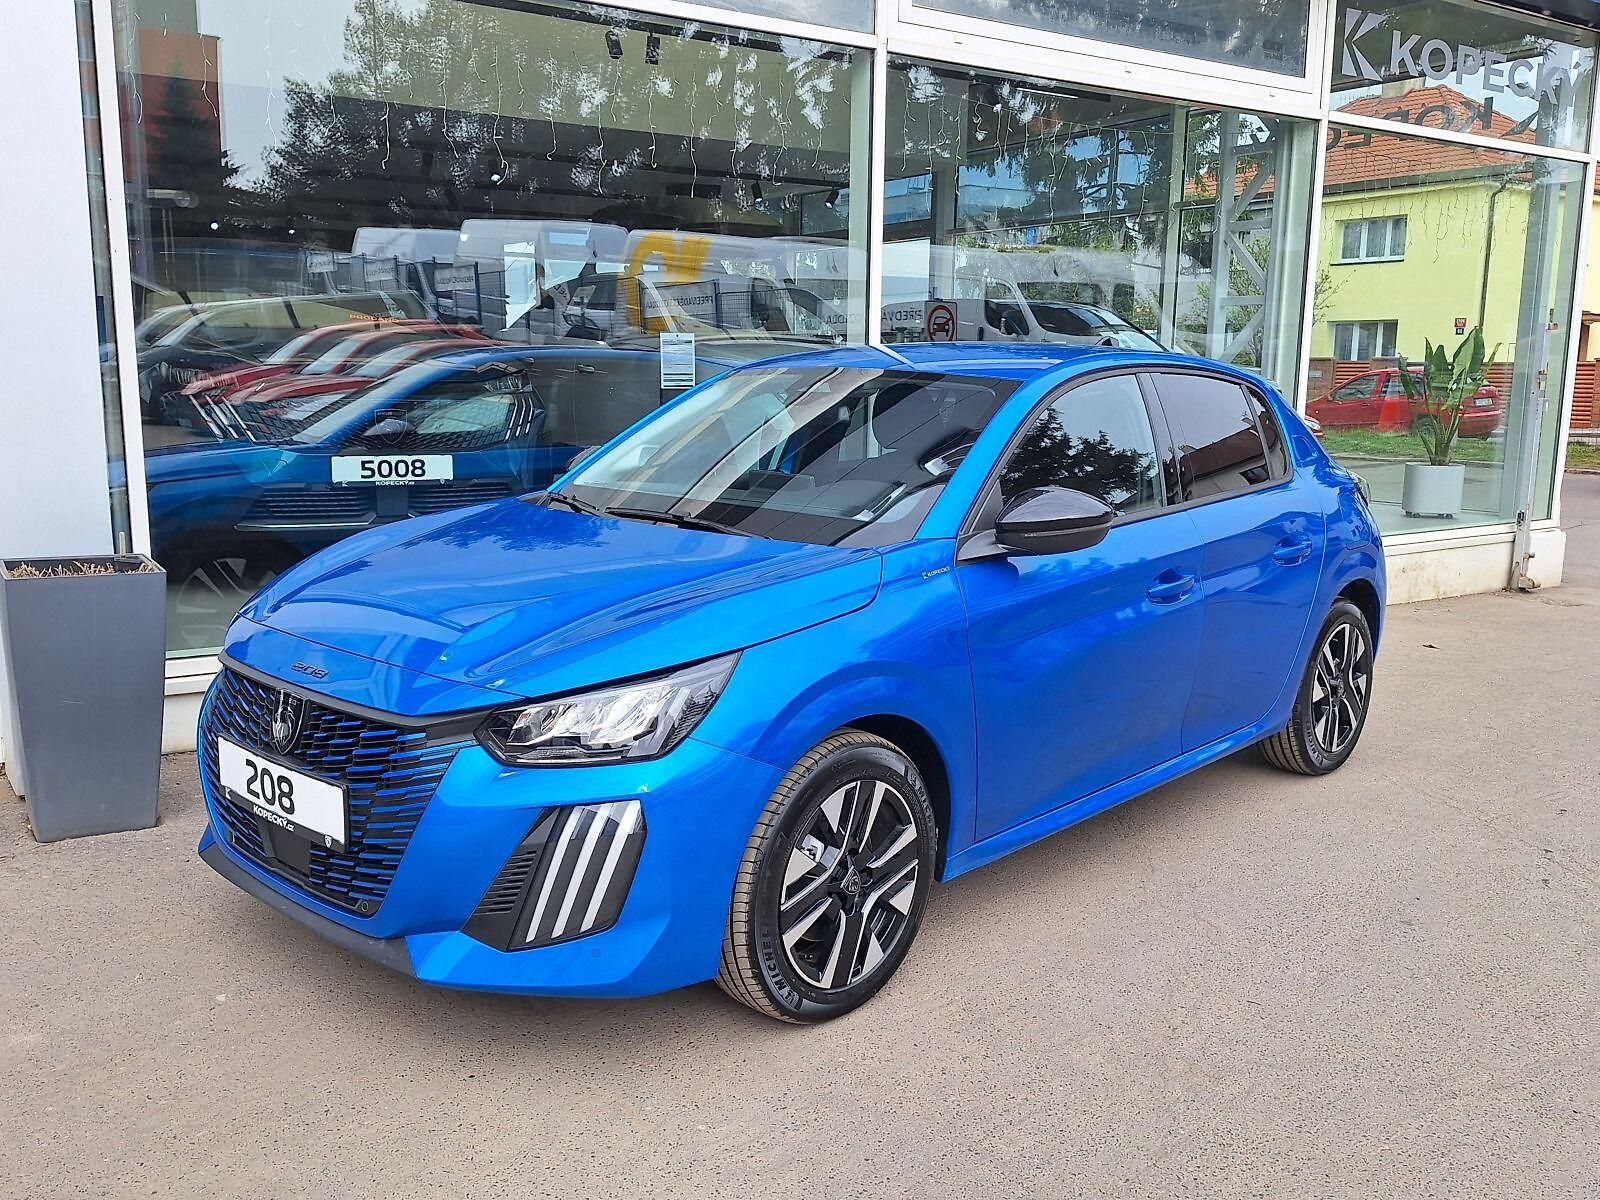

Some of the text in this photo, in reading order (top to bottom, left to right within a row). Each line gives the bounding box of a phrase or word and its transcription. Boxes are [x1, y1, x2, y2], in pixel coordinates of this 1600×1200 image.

[1390, 30, 1584, 108] KOPECKÝ
[360, 459, 426, 479] 5008
[290, 661, 330, 680] 208
[246, 758, 296, 815] 208
